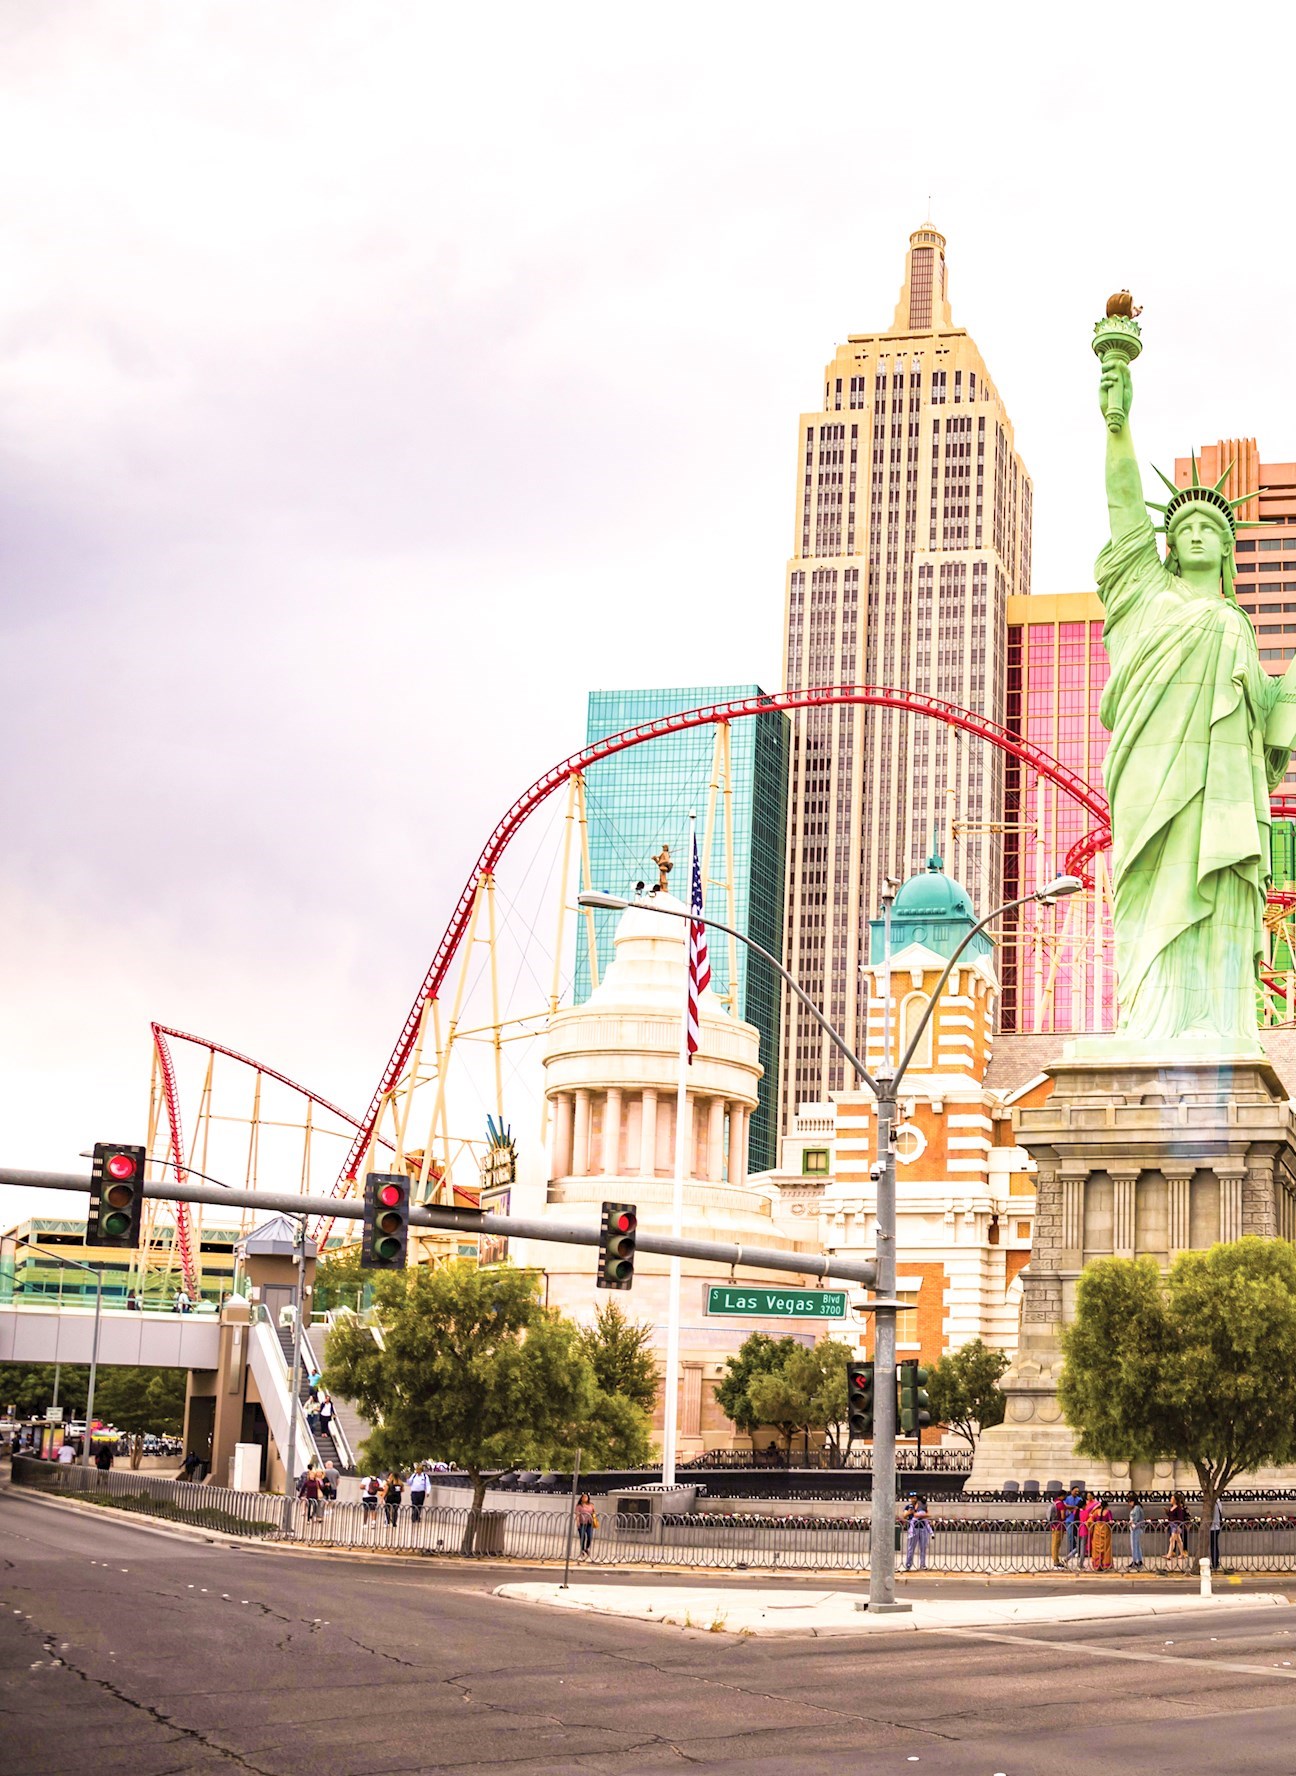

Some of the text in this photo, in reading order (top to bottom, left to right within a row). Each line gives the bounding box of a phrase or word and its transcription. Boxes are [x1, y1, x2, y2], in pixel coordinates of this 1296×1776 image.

[712, 1290, 841, 1314] S Las Vegas Blvd
[819, 1305, 841, 1315] 3700
